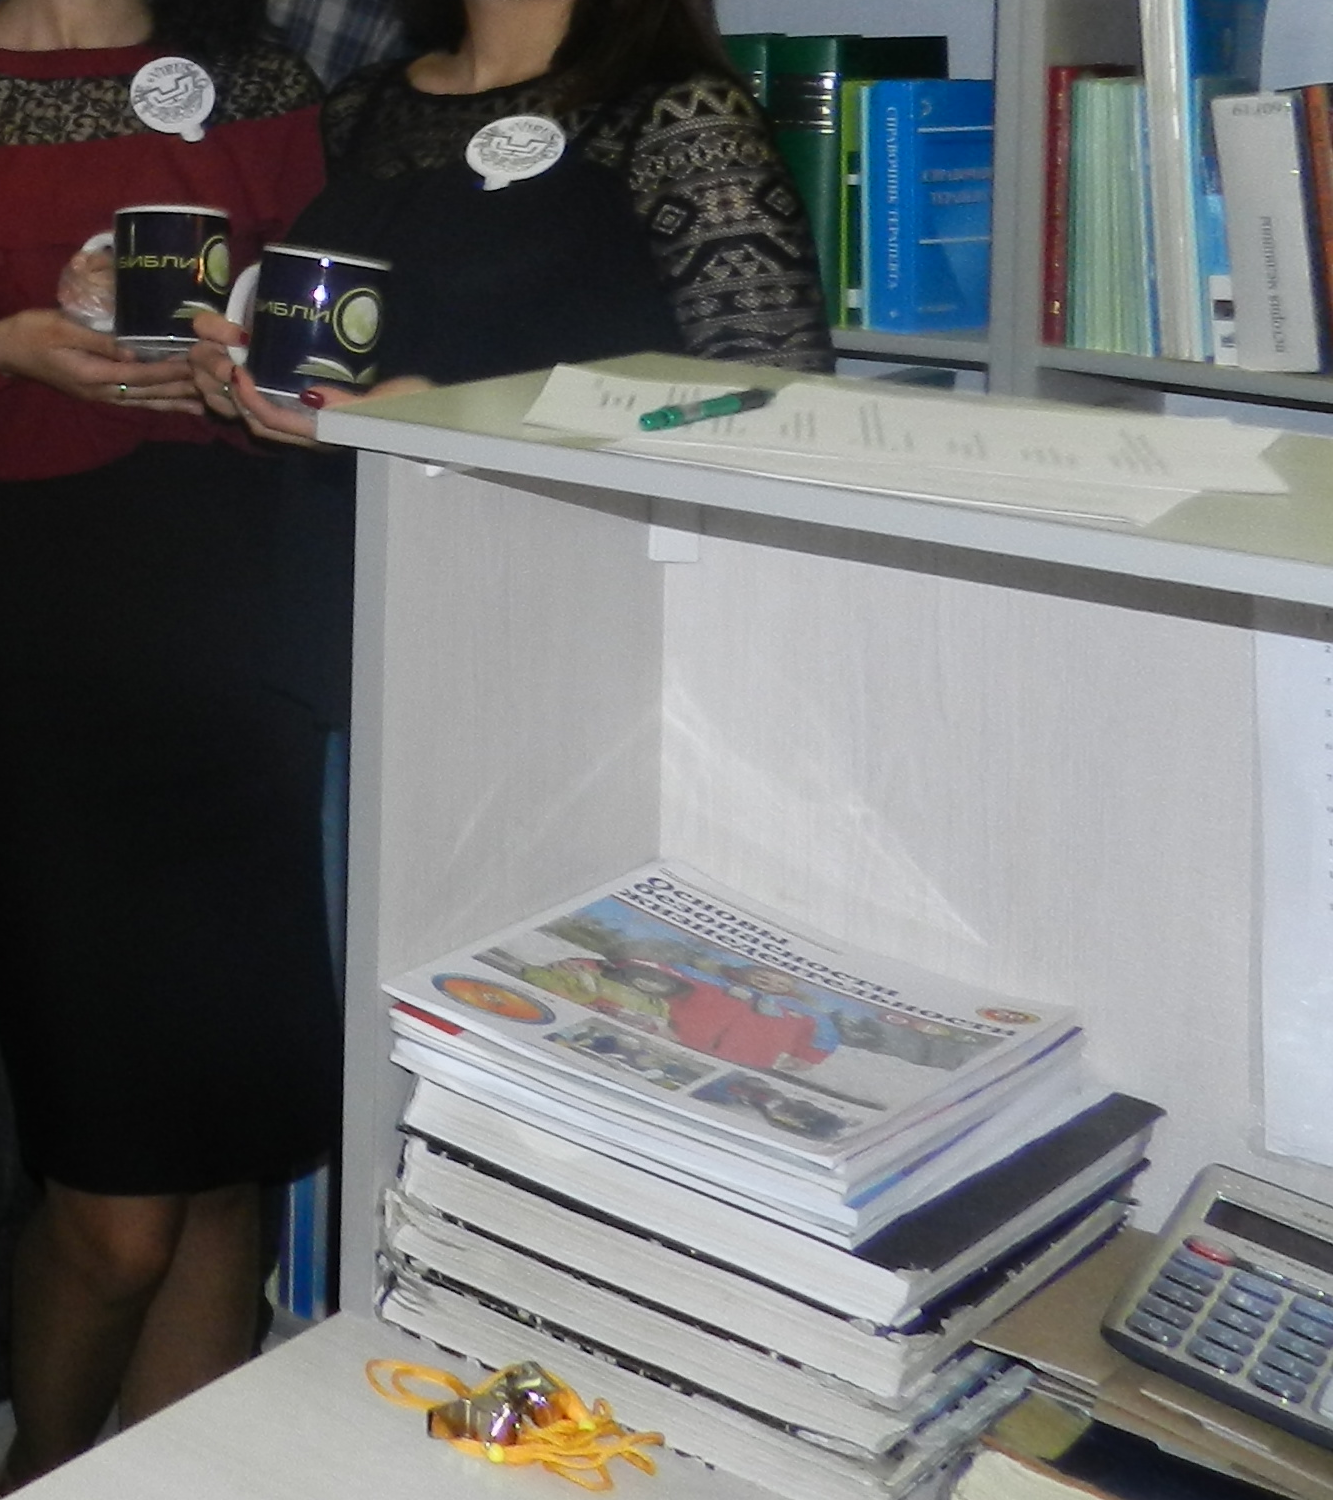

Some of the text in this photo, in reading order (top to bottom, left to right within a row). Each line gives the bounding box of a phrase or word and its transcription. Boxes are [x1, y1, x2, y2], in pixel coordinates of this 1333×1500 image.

[619, 887, 1018, 1037] жизнедеятельности
[632, 882, 901, 997] безопасности
[646, 876, 791, 946] Основы
